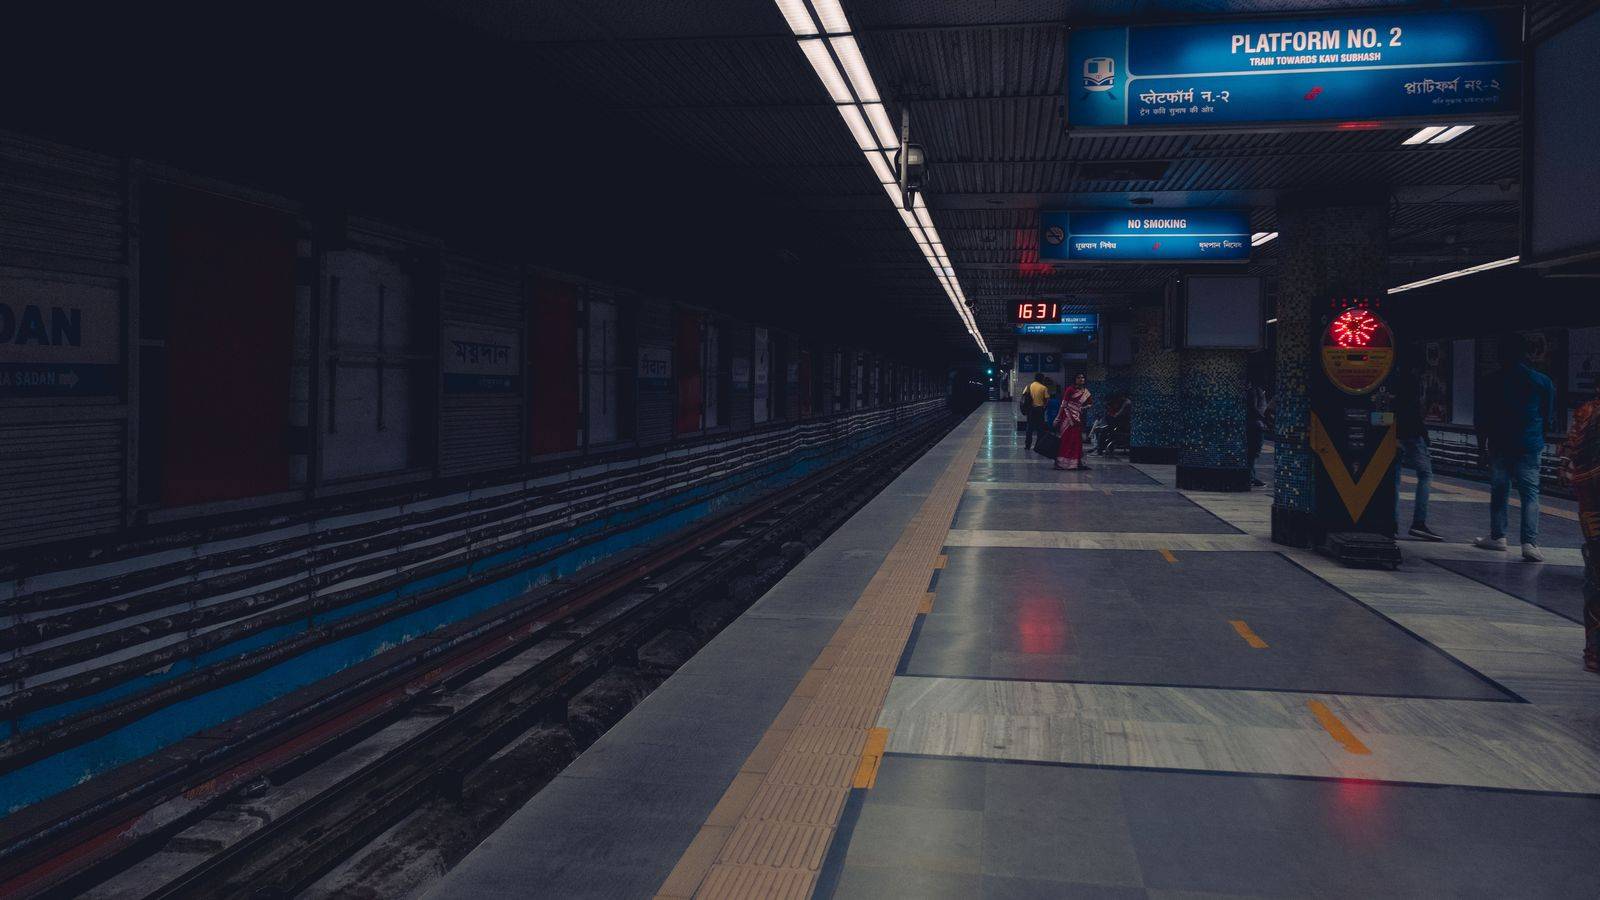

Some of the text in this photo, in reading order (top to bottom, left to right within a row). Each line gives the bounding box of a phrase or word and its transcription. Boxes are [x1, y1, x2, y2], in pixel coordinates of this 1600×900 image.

[1231, 27, 1403, 54] PLATFORM NO. 2
[1249, 52, 1382, 66] TRAIN TOWARDS KAVI SUBHASH
[1139, 88, 1194, 104] प्लेटफॉर्म
[1127, 219, 1187, 229] NO SMOKING
[16, 370, 56, 386] SADAN
